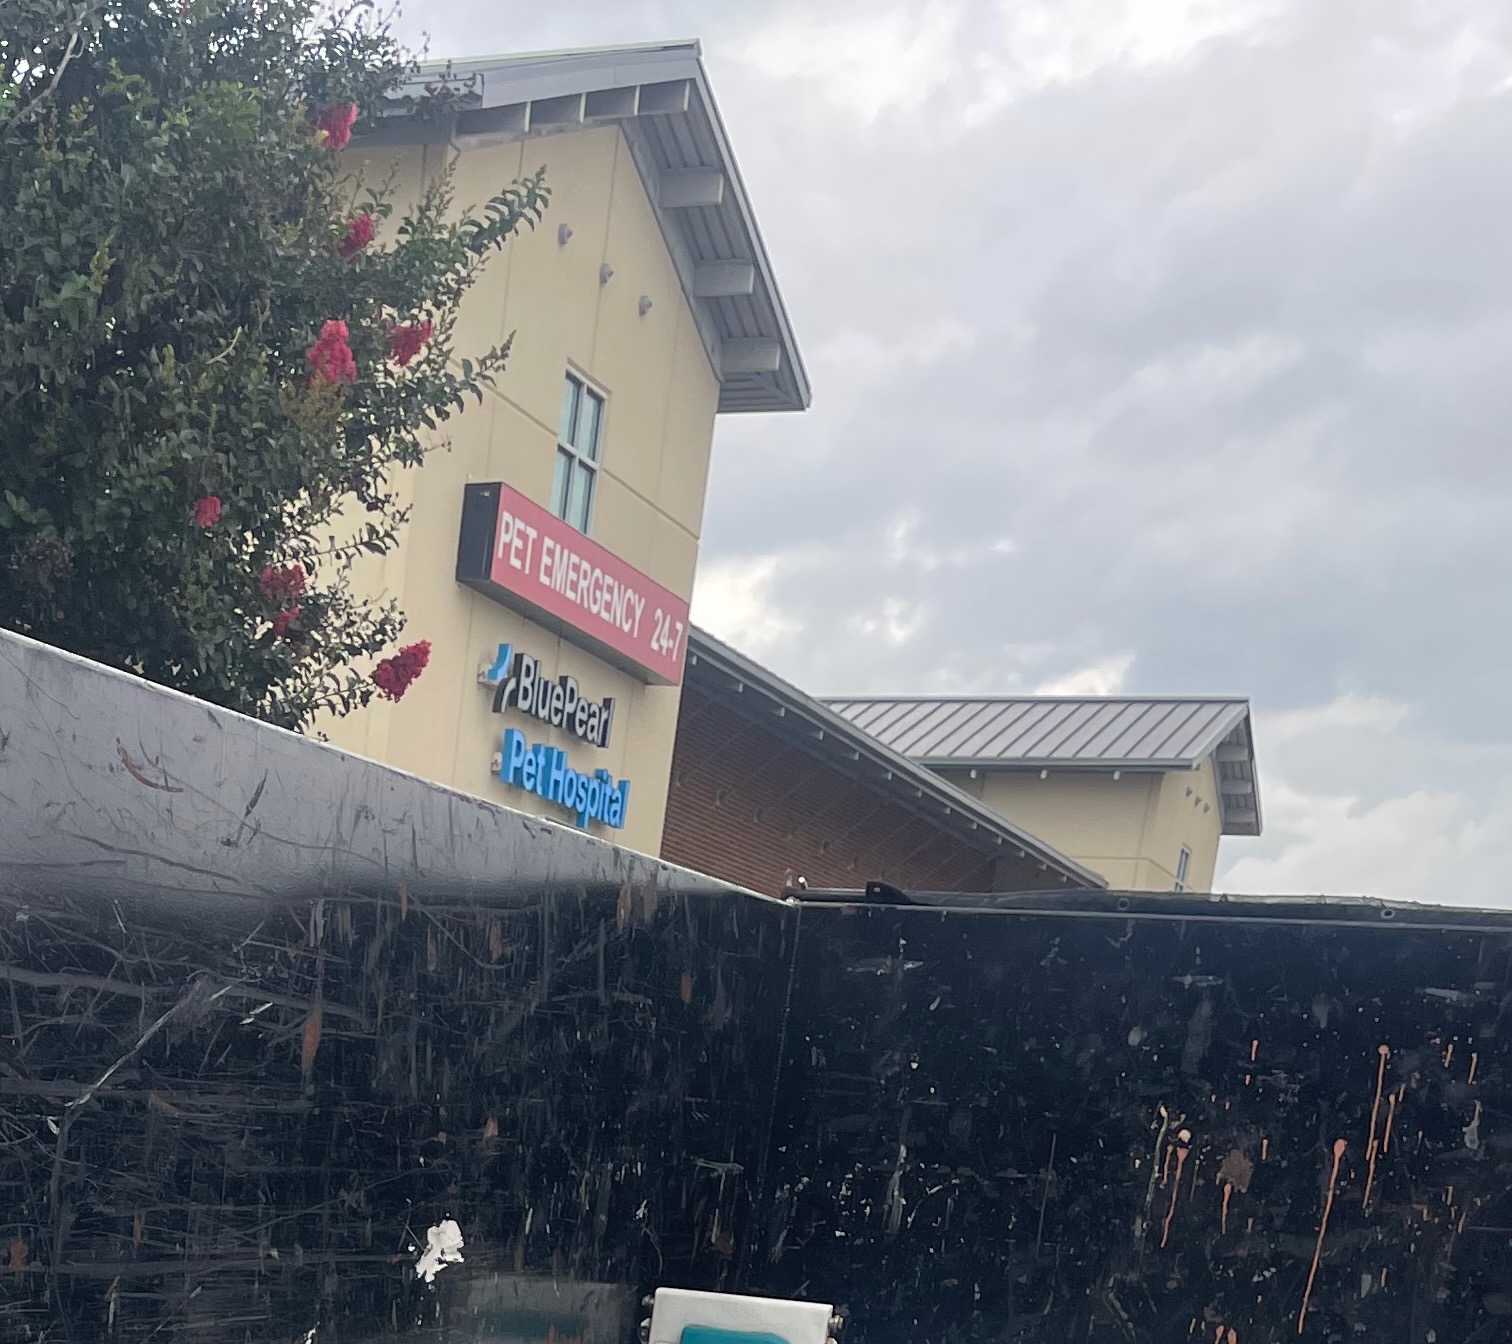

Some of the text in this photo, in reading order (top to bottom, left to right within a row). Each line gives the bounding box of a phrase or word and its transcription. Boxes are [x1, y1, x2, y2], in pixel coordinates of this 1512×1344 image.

[497, 510, 684, 662] PET EMERGENCY 24-7
[514, 653, 615, 748] BluePearl
[502, 728, 630, 829] Pet Hospital
